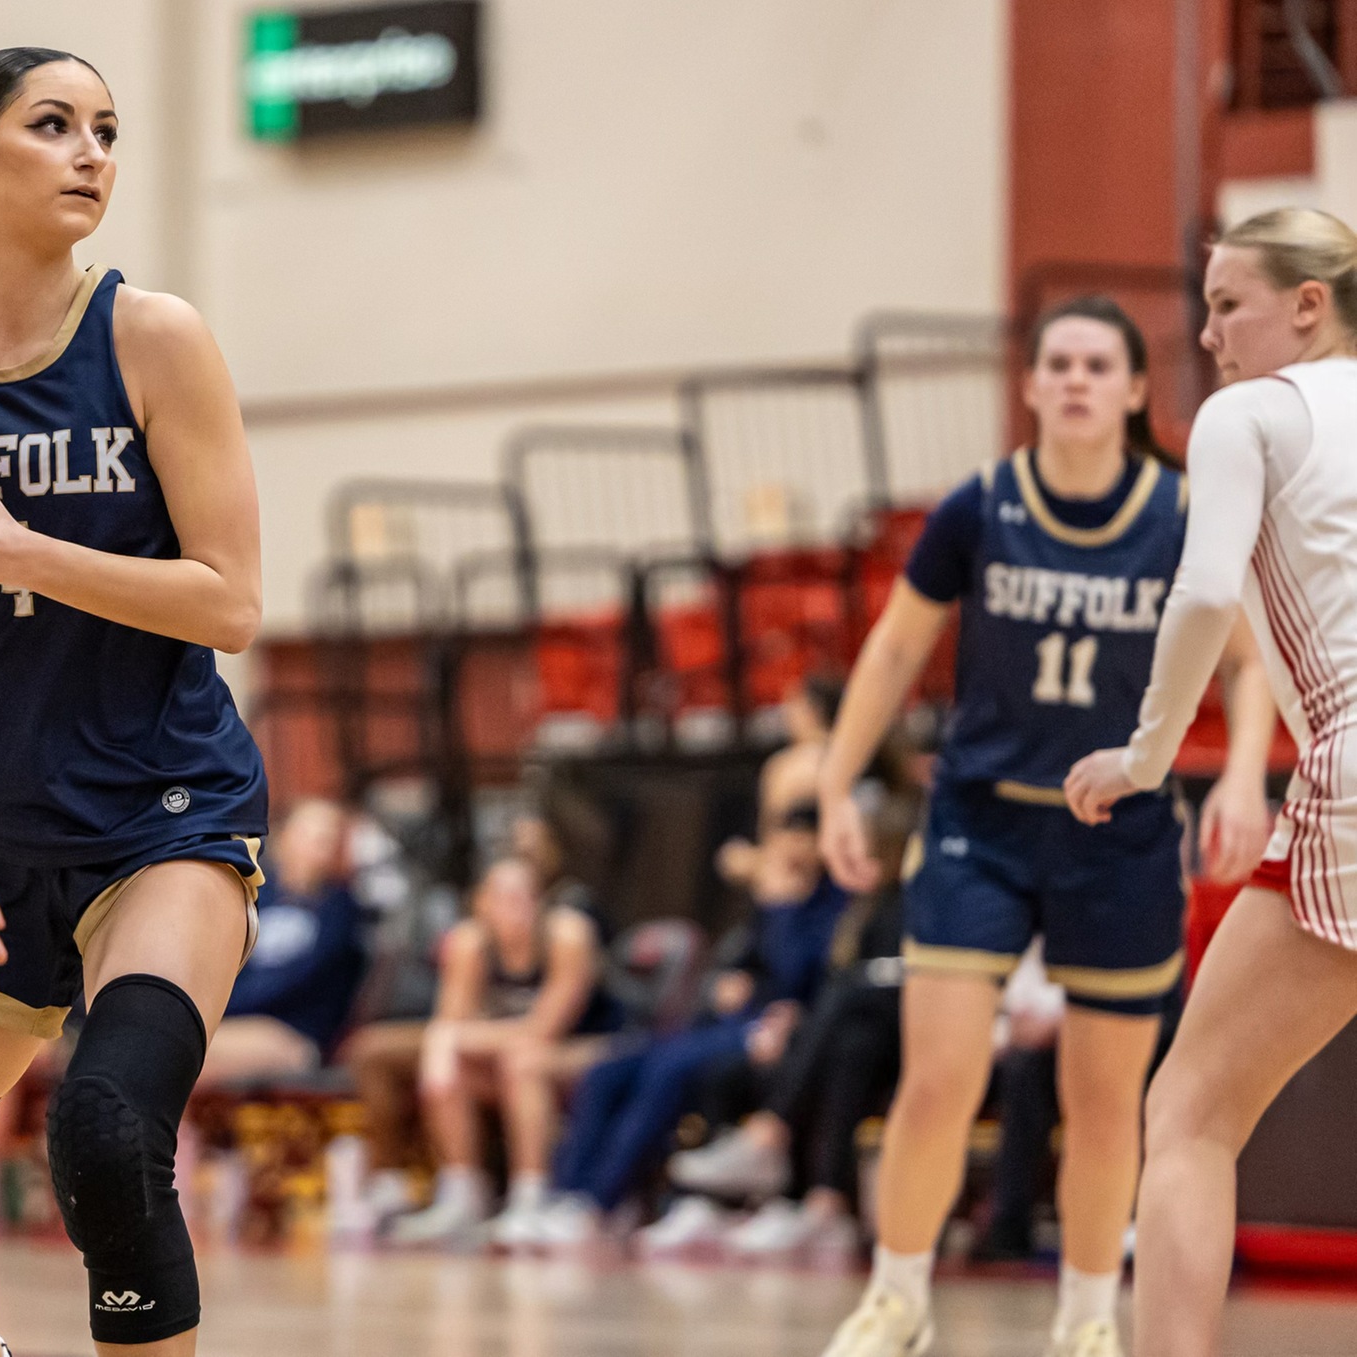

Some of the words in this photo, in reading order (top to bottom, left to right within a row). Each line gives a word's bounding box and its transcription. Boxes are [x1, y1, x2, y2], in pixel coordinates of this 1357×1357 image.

[984, 562, 1166, 631] SUFFOLK
[1032, 633, 1097, 707] 11
[168, 793, 183, 801] MD
